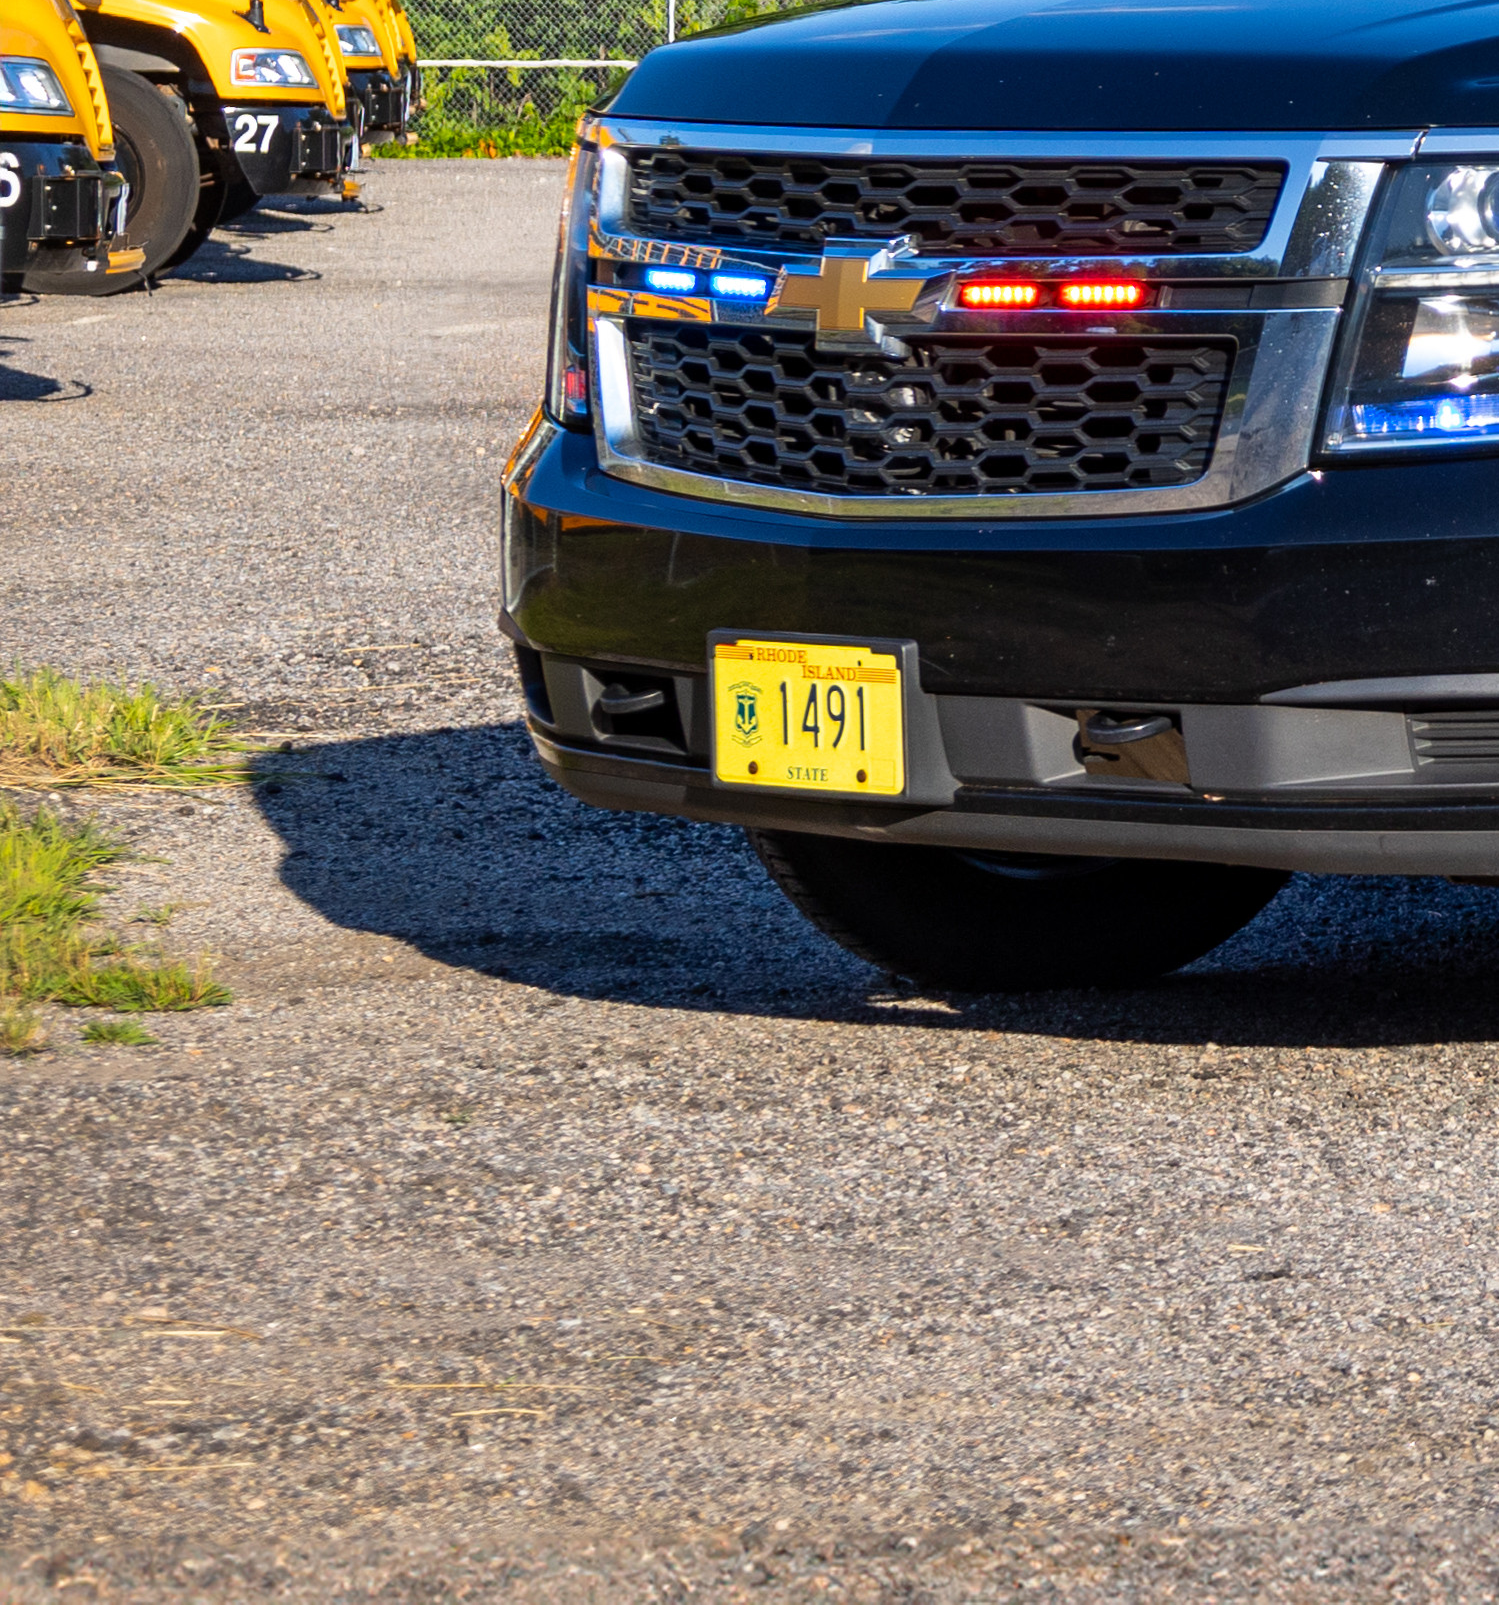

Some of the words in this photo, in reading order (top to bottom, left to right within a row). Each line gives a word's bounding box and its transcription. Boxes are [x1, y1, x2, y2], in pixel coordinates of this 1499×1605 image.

[233, 113, 280, 154] 27
[756, 647, 808, 664] RHODE
[801, 664, 858, 682] ISLAND
[779, 680, 866, 752] 1491
[786, 765, 829, 782] STATE
